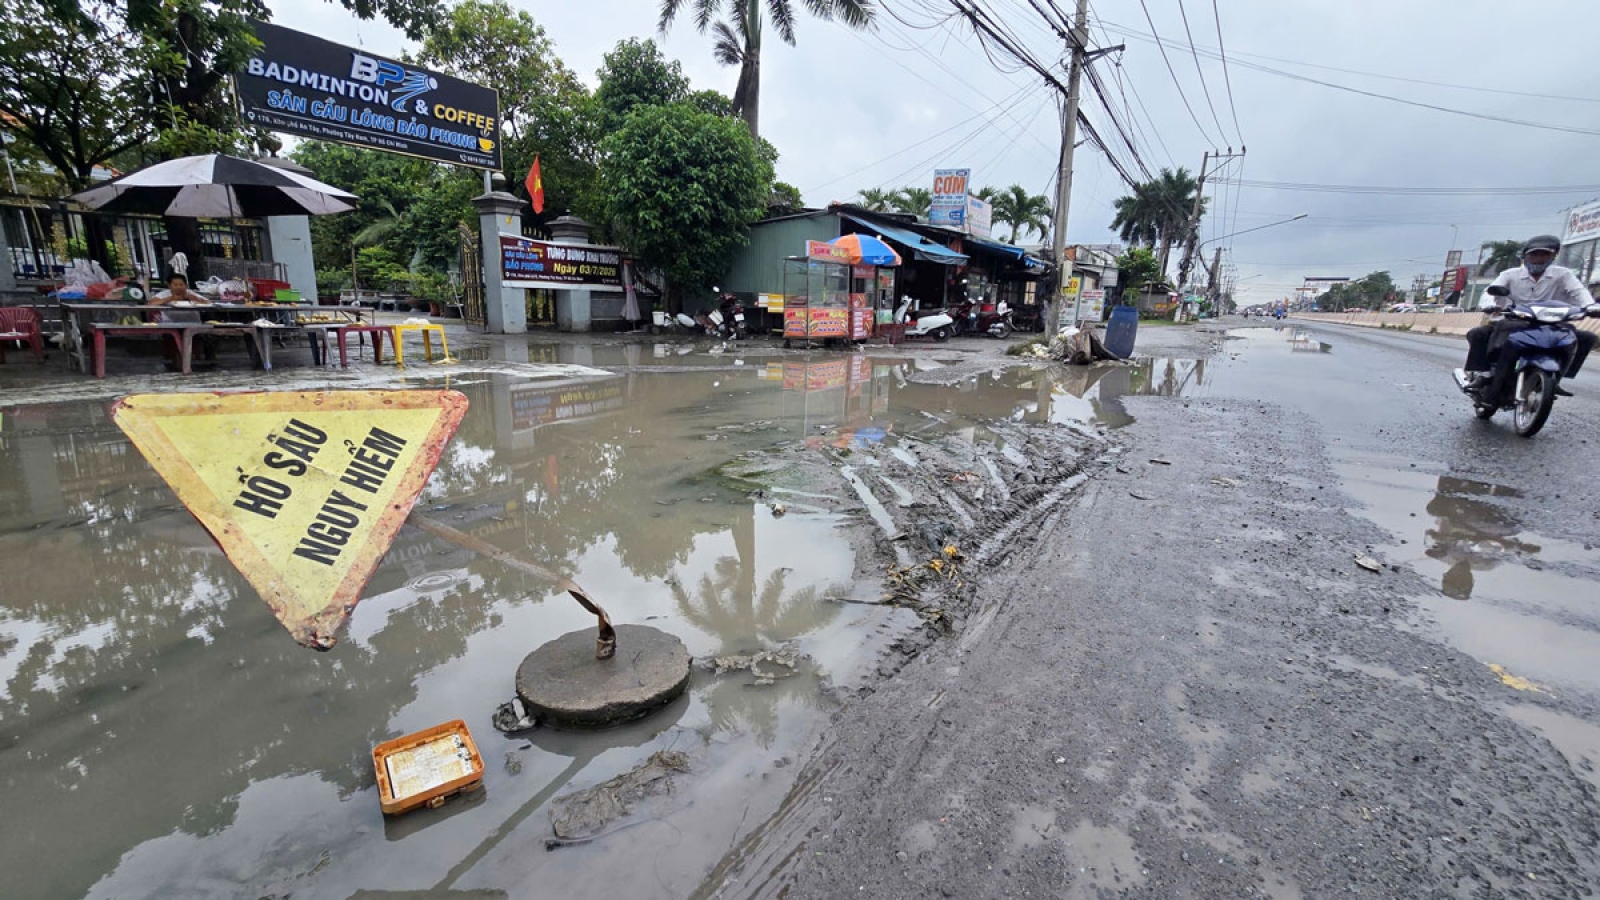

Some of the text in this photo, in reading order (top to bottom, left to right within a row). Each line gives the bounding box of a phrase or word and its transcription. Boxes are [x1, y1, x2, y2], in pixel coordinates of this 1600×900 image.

[248, 58, 495, 132] BADMINTON & COFFEE
[267, 88, 477, 150] SÂN CẦU LÔNG BẢO PHONG
[934, 174, 966, 194] CƠM
[553, 263, 577, 275] Ngày
[233, 418, 328, 519] HỐ SÂU
[292, 426, 407, 566] NGUY HIỂM
